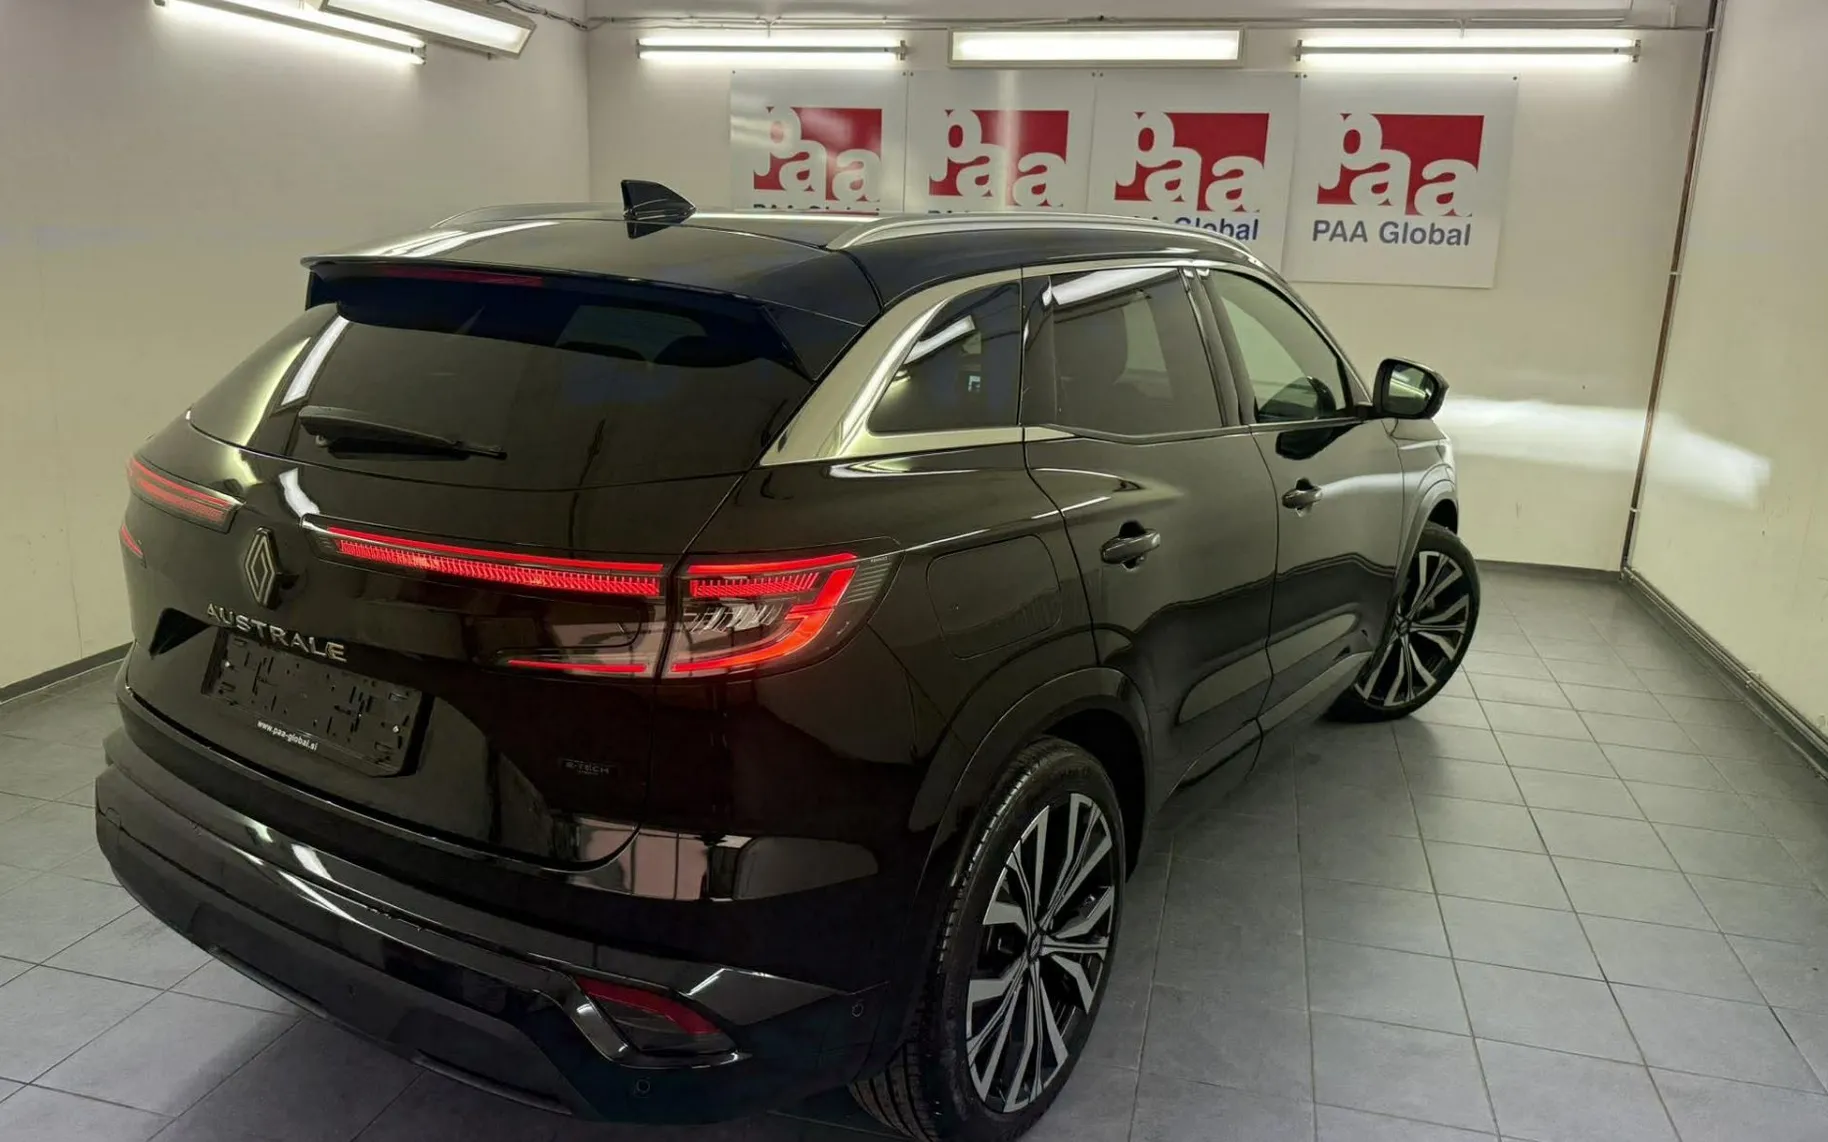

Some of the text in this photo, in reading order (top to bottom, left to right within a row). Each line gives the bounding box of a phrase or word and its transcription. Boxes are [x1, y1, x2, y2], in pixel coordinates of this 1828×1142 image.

[929, 109, 1069, 207] paa
[1114, 112, 1270, 212] paa
[1317, 113, 1484, 217] paa
[1312, 219, 1471, 247] PAA Global
[206, 602, 348, 663] AUSTRALE
[256, 719, 319, 752] www.paa-global.si
